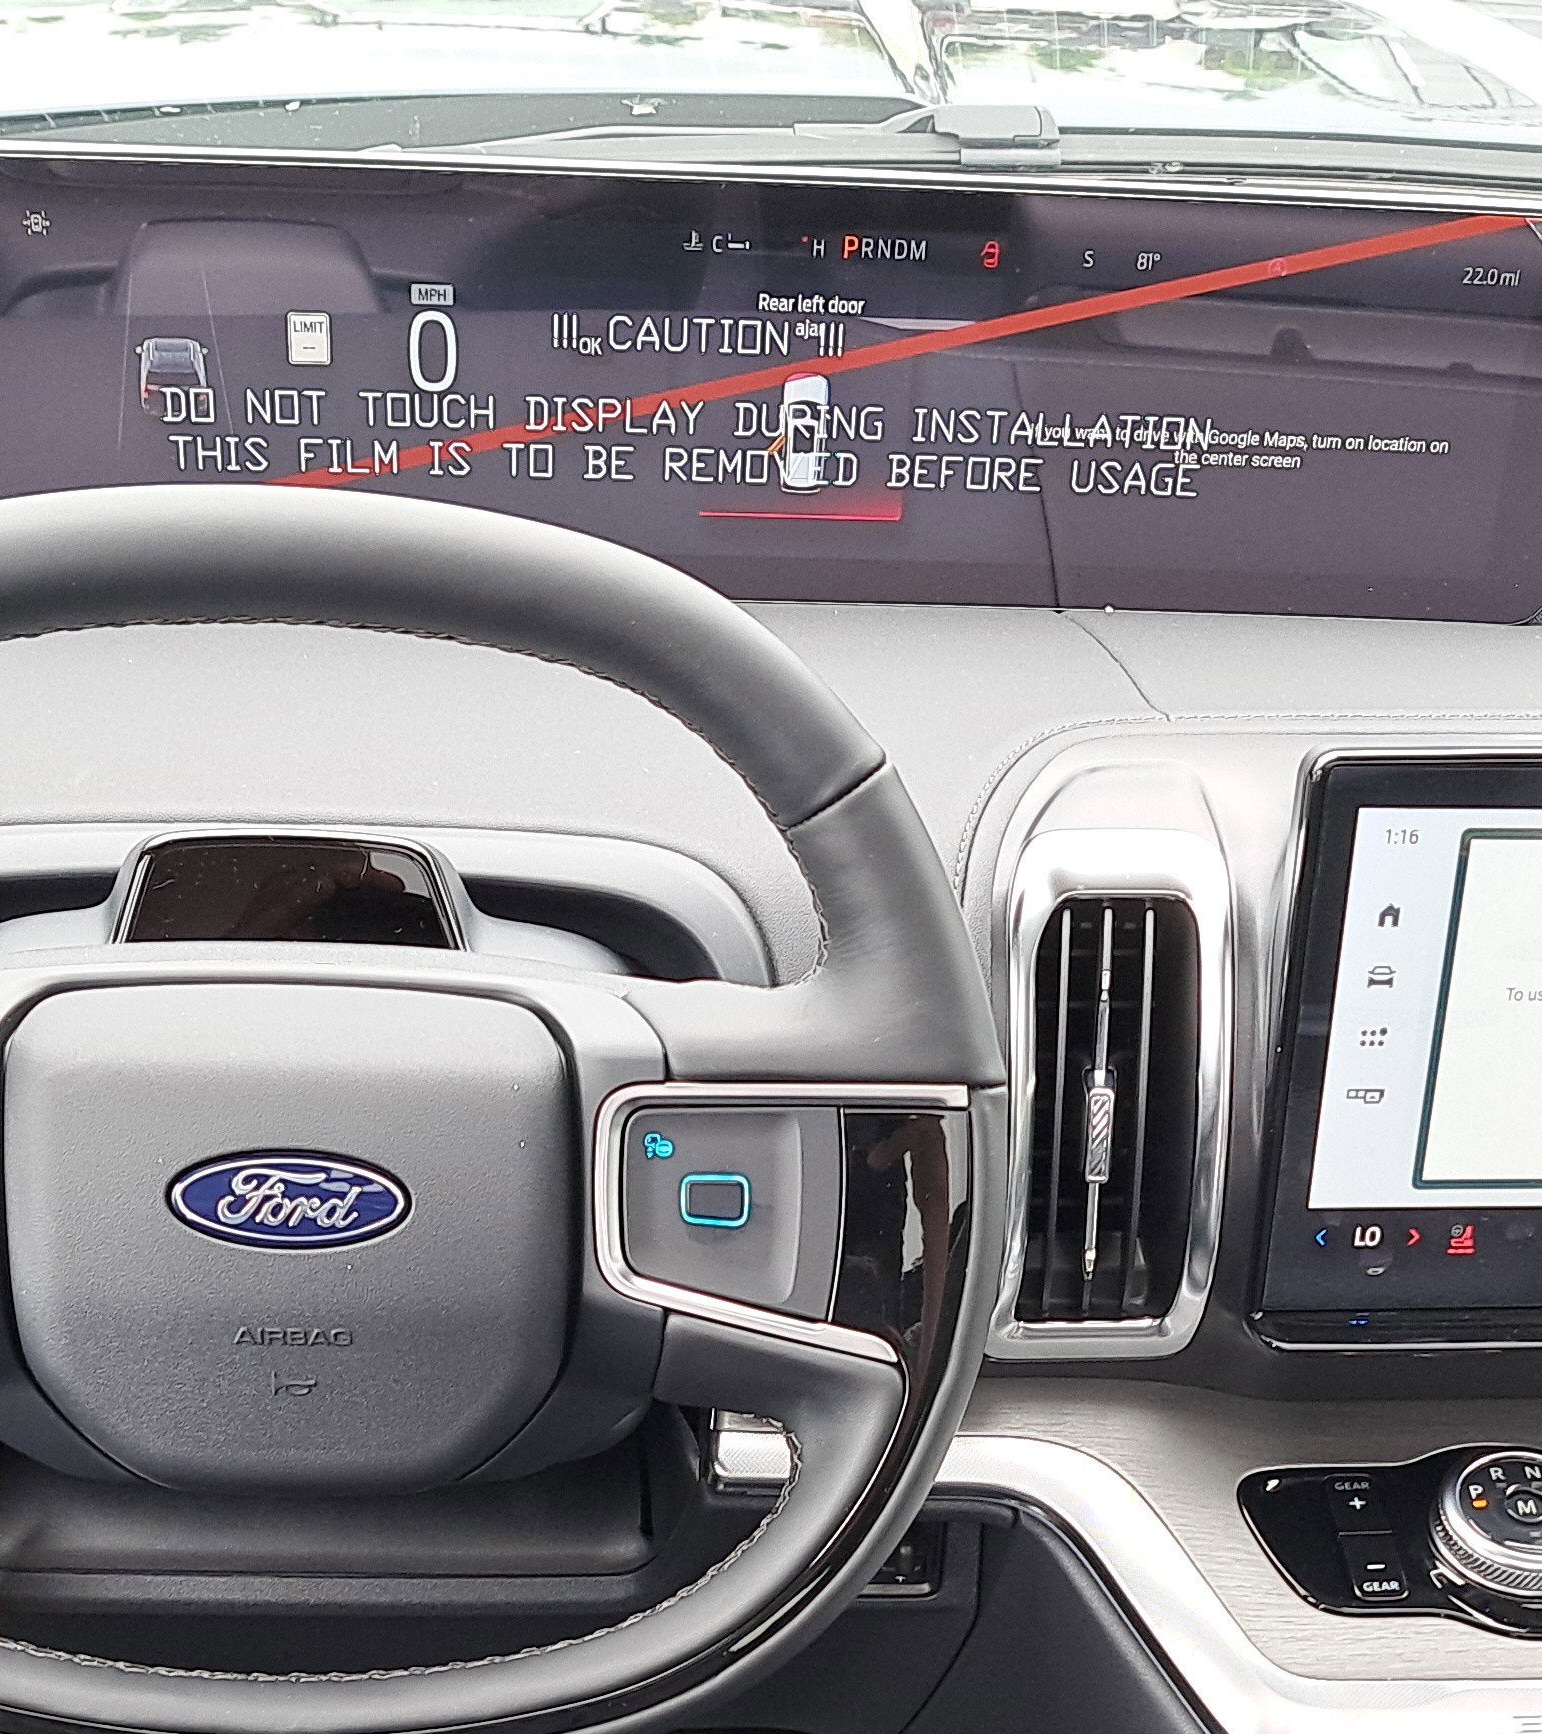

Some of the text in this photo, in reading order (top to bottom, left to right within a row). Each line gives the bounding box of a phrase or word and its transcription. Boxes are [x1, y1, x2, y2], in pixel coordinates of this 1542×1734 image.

[812, 239, 826, 258] H
[1083, 250, 1095, 268] S
[1462, 267, 1498, 287] 22.0
[418, 287, 447, 302] MPH
[758, 293, 865, 315] Rear left door
[294, 321, 324, 335] LIMIT
[608, 314, 790, 356] CAUTION
[408, 310, 457, 392] 0
[579, 336, 602, 355] OK
[160, 387, 1213, 451] DO NOT TOUCH DISPLAY DURING INSTALLATION
[1209, 429, 1259, 453] Google
[1264, 431, 1308, 452] Maps,
[1312, 434, 1343, 450] turn
[1345, 437, 1364, 451] on
[1367, 434, 1426, 453] location
[1430, 438, 1449, 453] on
[168, 435, 1199, 497] THIS FILM IS TO BE REMOVED BEFORE USAGE
[1174, 449, 1301, 469] the center screen
[1385, 828, 1420, 846] 1:16
[1507, 987, 1527, 1002] To
[218, 1167, 362, 1228] Ford
[1353, 1226, 1382, 1248] LO
[233, 1326, 354, 1347] AIRBAG
[1490, 1467, 1506, 1481] R
[1524, 1466, 1541, 1479] N
[1334, 1482, 1370, 1491] GEAR
[1468, 1485, 1484, 1499] P
[1516, 1500, 1537, 1515] M
[1363, 1581, 1401, 1592] GEAR
